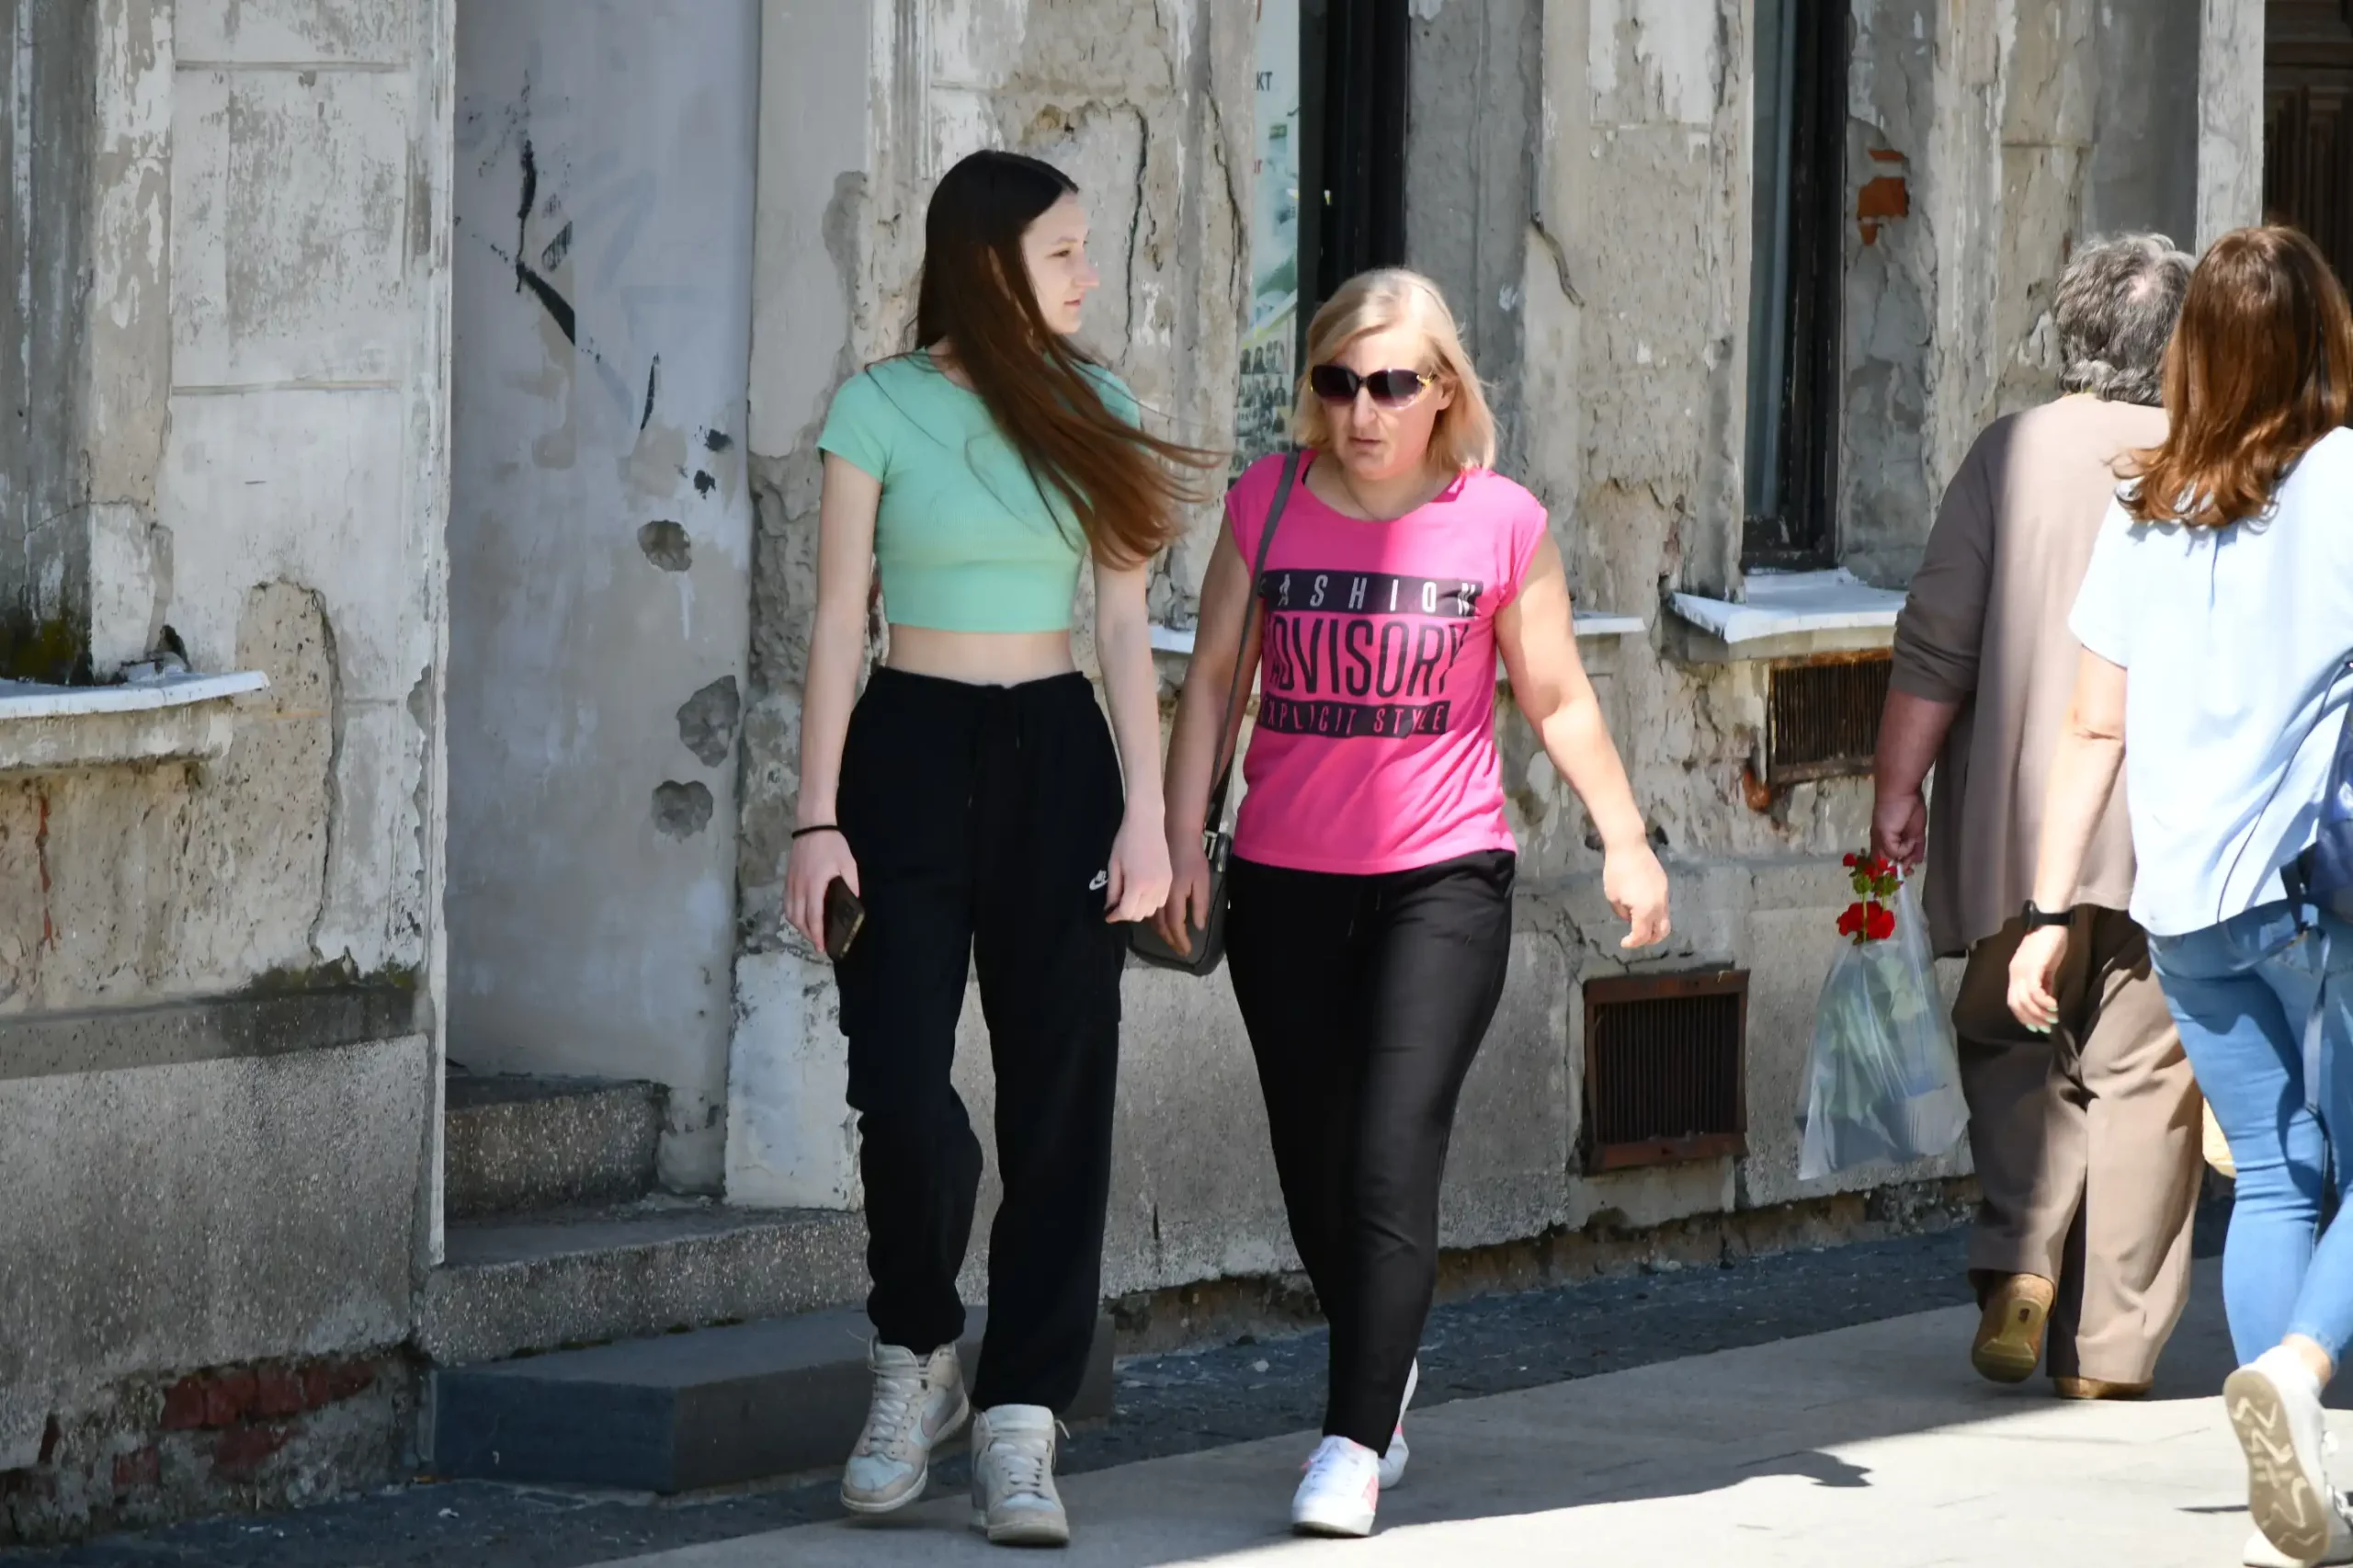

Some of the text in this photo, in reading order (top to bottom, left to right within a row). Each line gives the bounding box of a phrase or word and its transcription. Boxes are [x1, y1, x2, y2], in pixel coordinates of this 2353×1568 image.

[1259, 573, 1476, 617] ASHION
[1262, 697, 1445, 735] XPLICIT STYLE
